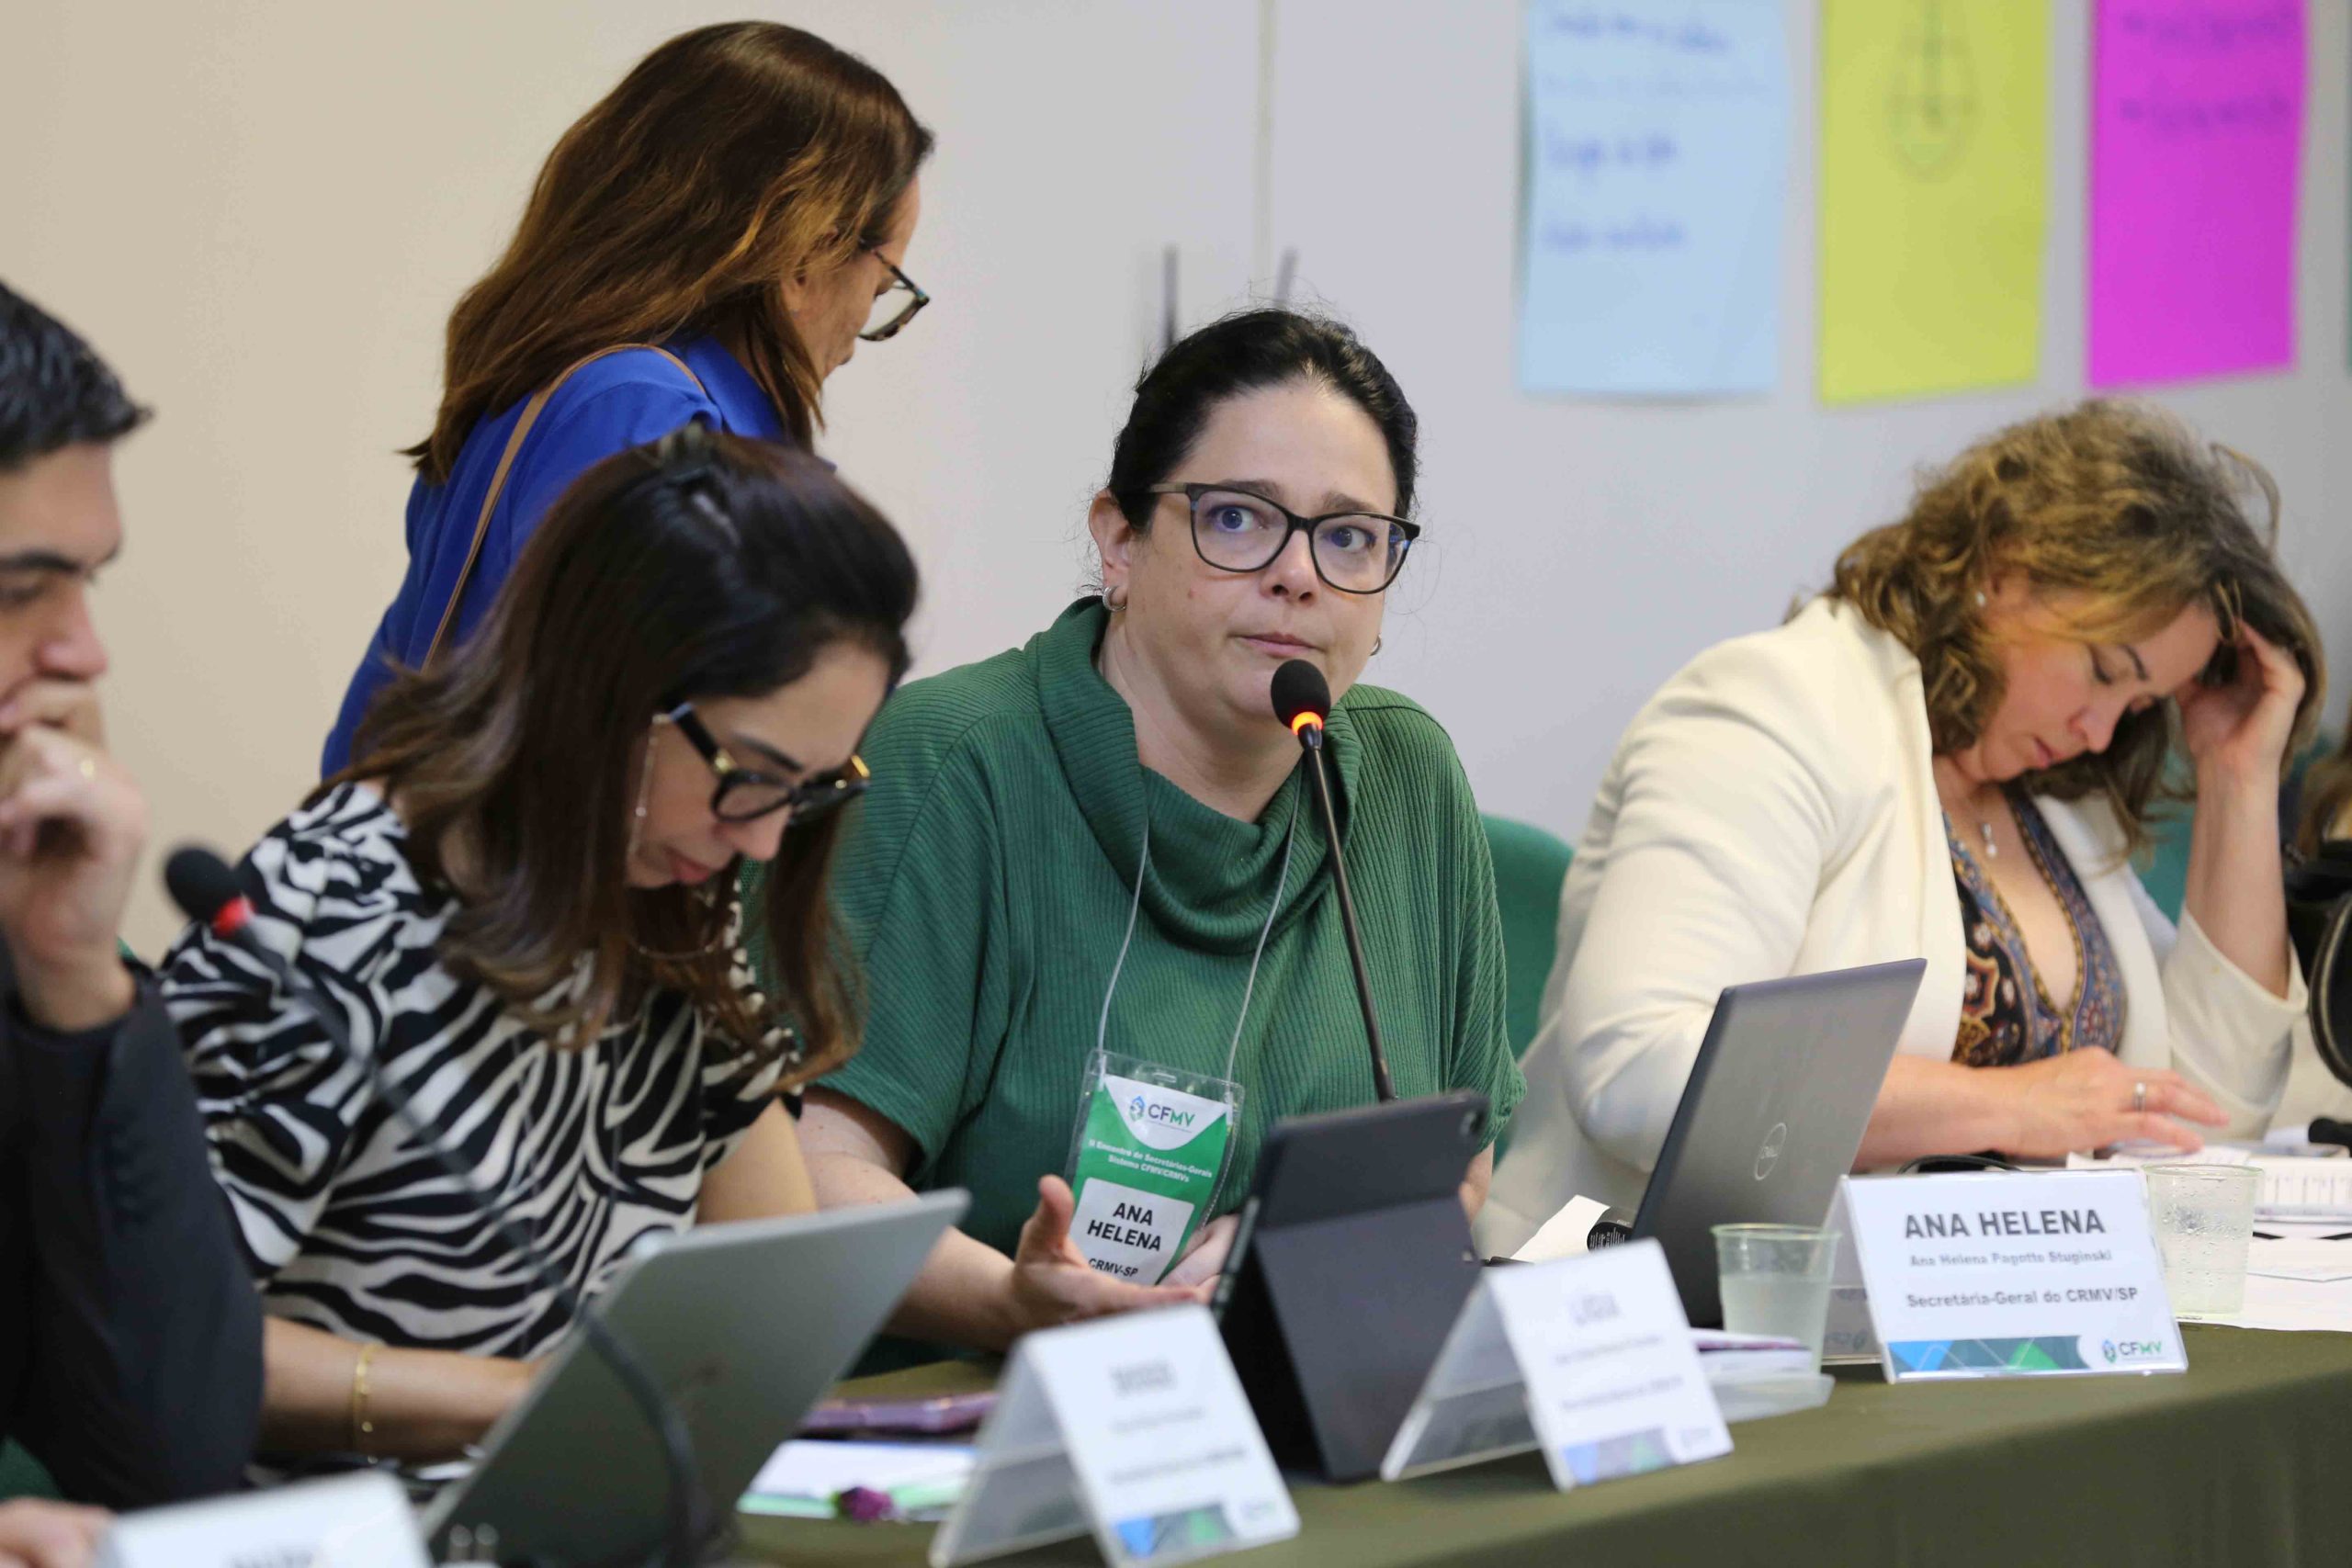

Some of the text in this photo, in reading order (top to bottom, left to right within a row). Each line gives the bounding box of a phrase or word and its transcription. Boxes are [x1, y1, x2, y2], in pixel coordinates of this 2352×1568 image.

[1148, 1104, 1195, 1127] CFMV
[1113, 1202, 1153, 1226] ANA
[1905, 1209, 2106, 1239] ANA HELENA
[1087, 1219, 1161, 1251] HELENA
[1088, 1258, 1139, 1278] CRMV-SP
[1910, 1255, 1936, 1267] Ana
[1939, 1253, 1988, 1265] Helena
[1906, 1286, 2139, 1307] Secretária-Geral do CRMV/SP
[2119, 1341, 2162, 1357] CFMV
